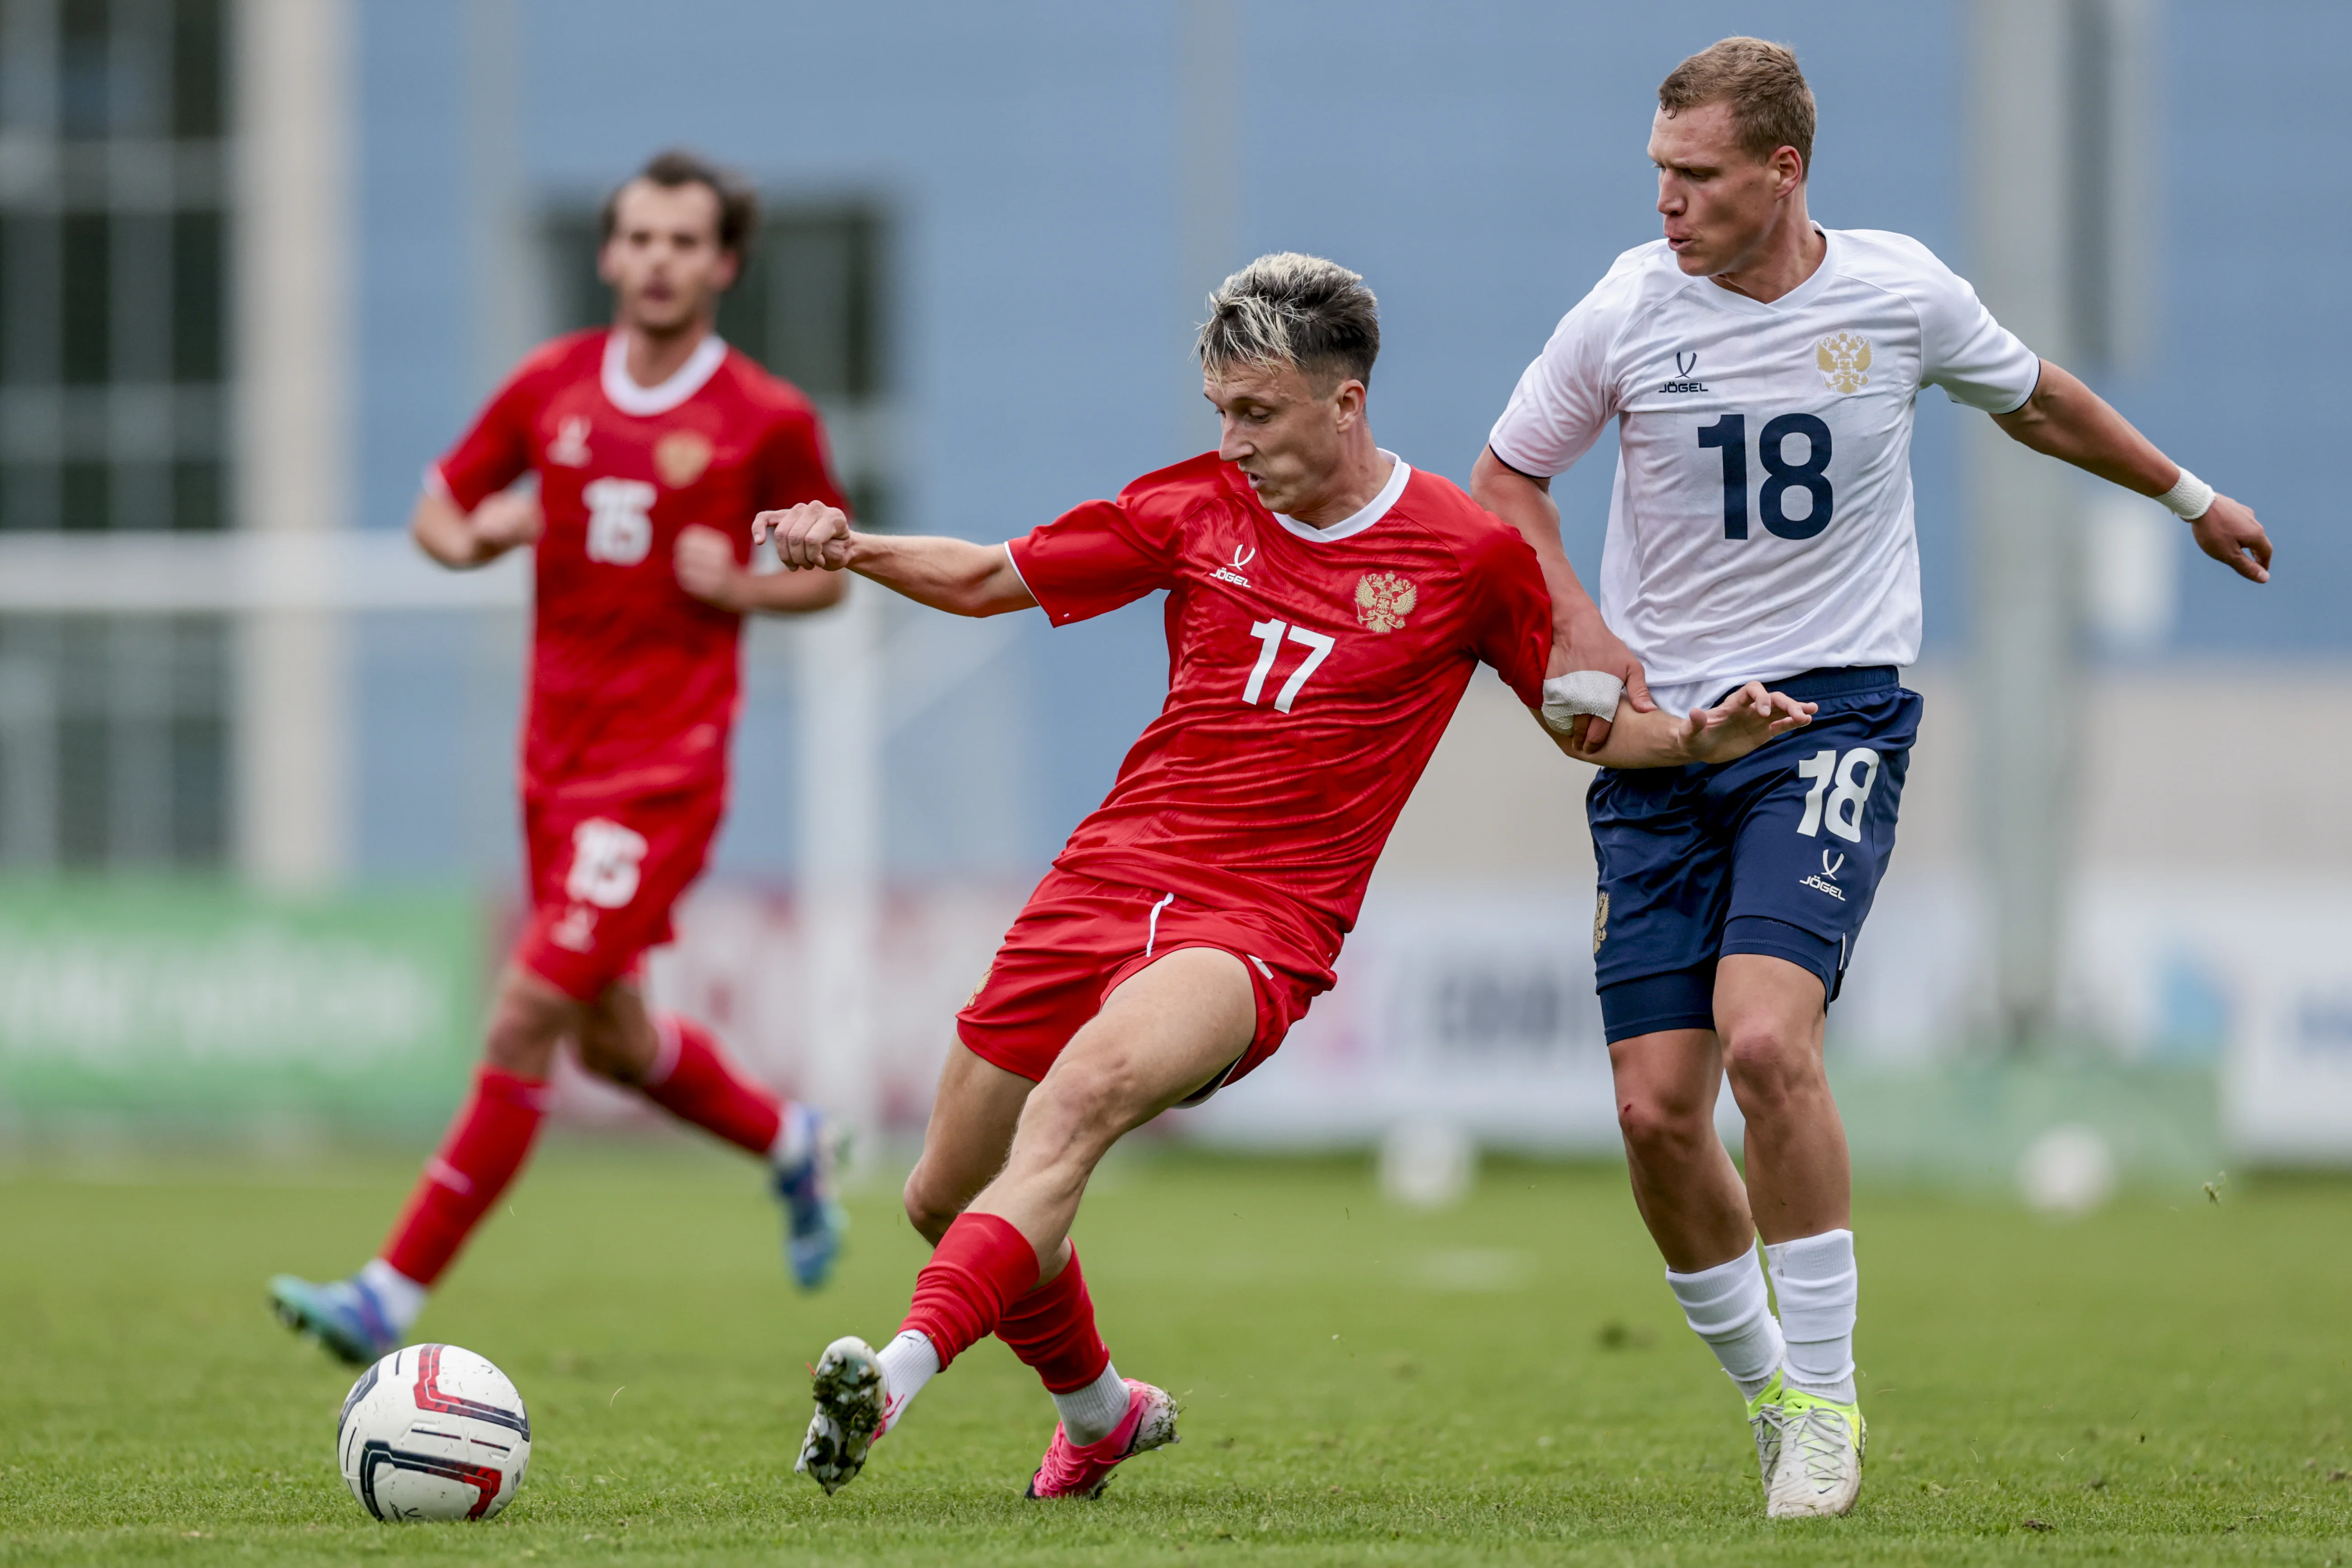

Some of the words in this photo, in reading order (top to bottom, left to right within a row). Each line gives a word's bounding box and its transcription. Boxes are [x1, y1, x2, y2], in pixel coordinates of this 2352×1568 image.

[1658, 382, 1709, 393] JÖGEL
[583, 476, 657, 566] 15
[1697, 413, 1833, 540] 18
[1209, 567, 1251, 588] JÖGEL
[1242, 618, 1336, 714] 17
[1796, 747, 1880, 843] 18
[1799, 875, 1846, 901] JÖGEL
